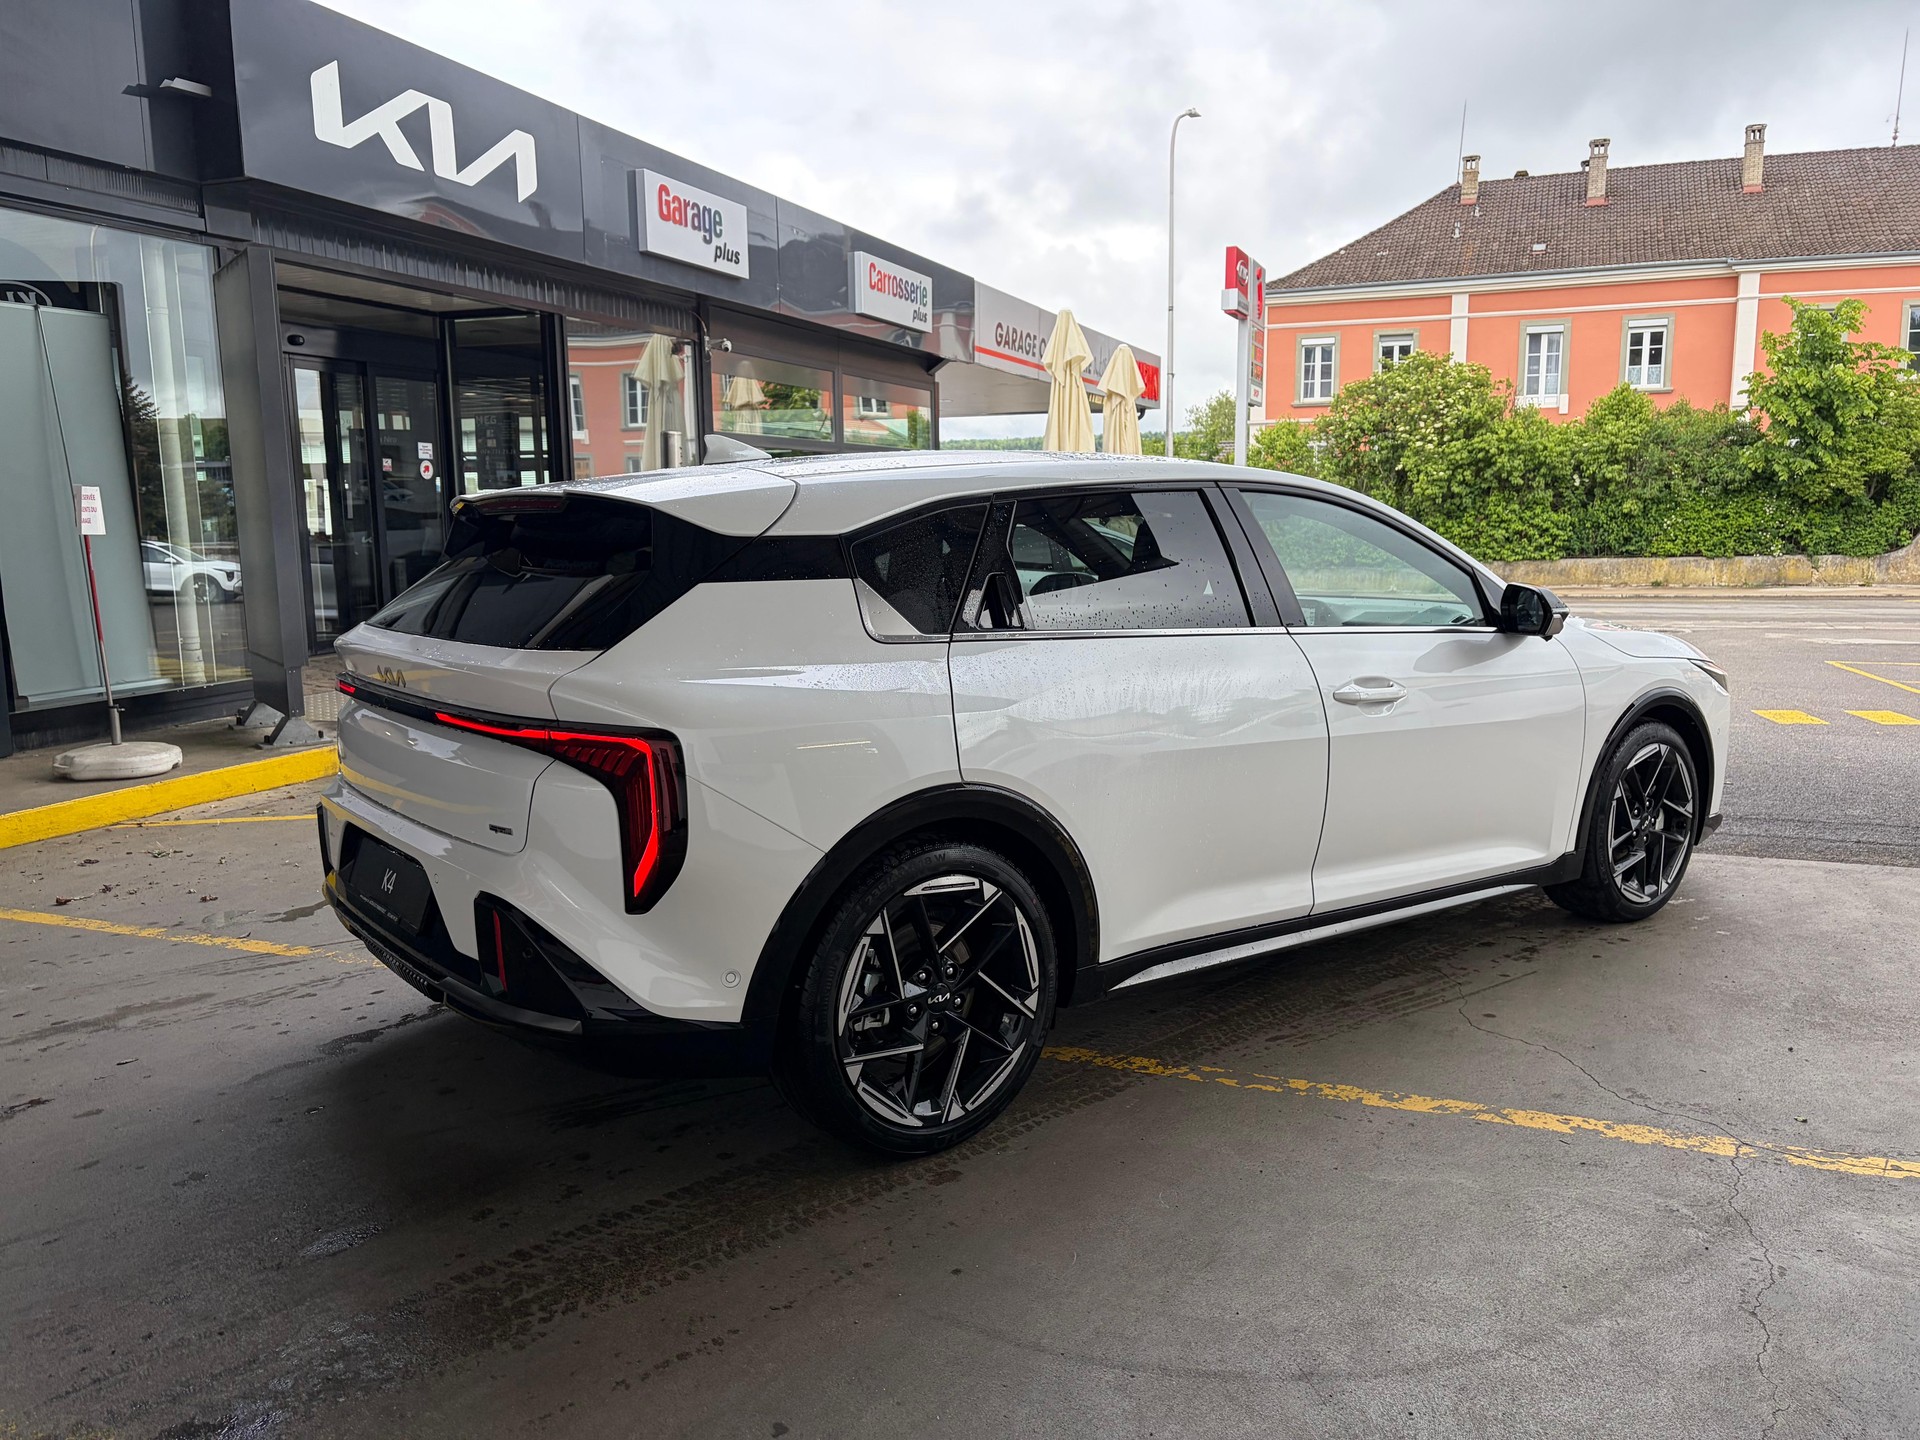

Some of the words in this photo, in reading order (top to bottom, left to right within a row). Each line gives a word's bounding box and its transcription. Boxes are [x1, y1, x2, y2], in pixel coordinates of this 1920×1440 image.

[657, 183, 723, 244] Garage
[713, 243, 741, 265] plus
[868, 262, 928, 308] Carrosserie
[912, 308, 928, 323] plus
[995, 322, 1037, 357] GARAGE
[381, 868, 397, 894] K4
